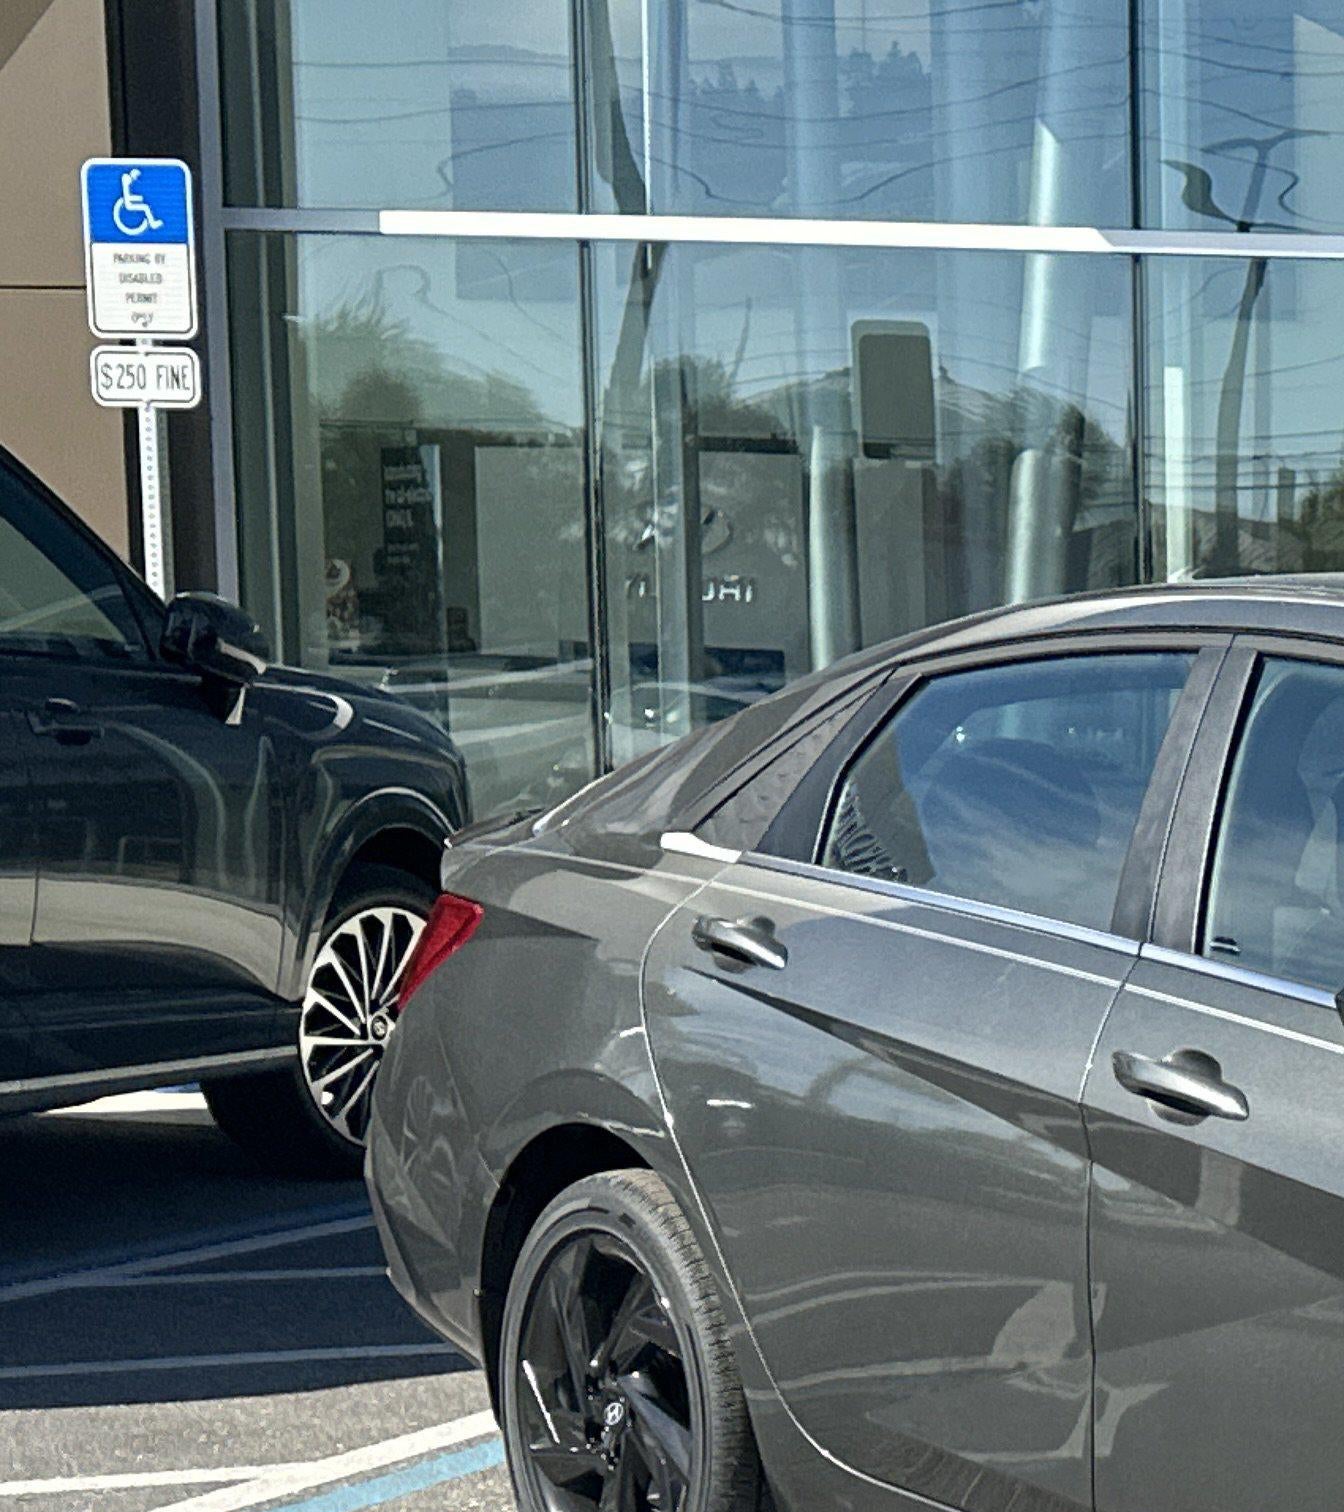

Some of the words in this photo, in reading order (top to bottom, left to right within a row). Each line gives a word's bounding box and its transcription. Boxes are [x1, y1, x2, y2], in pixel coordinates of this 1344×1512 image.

[113, 252, 151, 265] PARKING
[118, 272, 163, 285] DISABLED
[100, 362, 147, 391] $250
[156, 364, 191, 392] FINE
